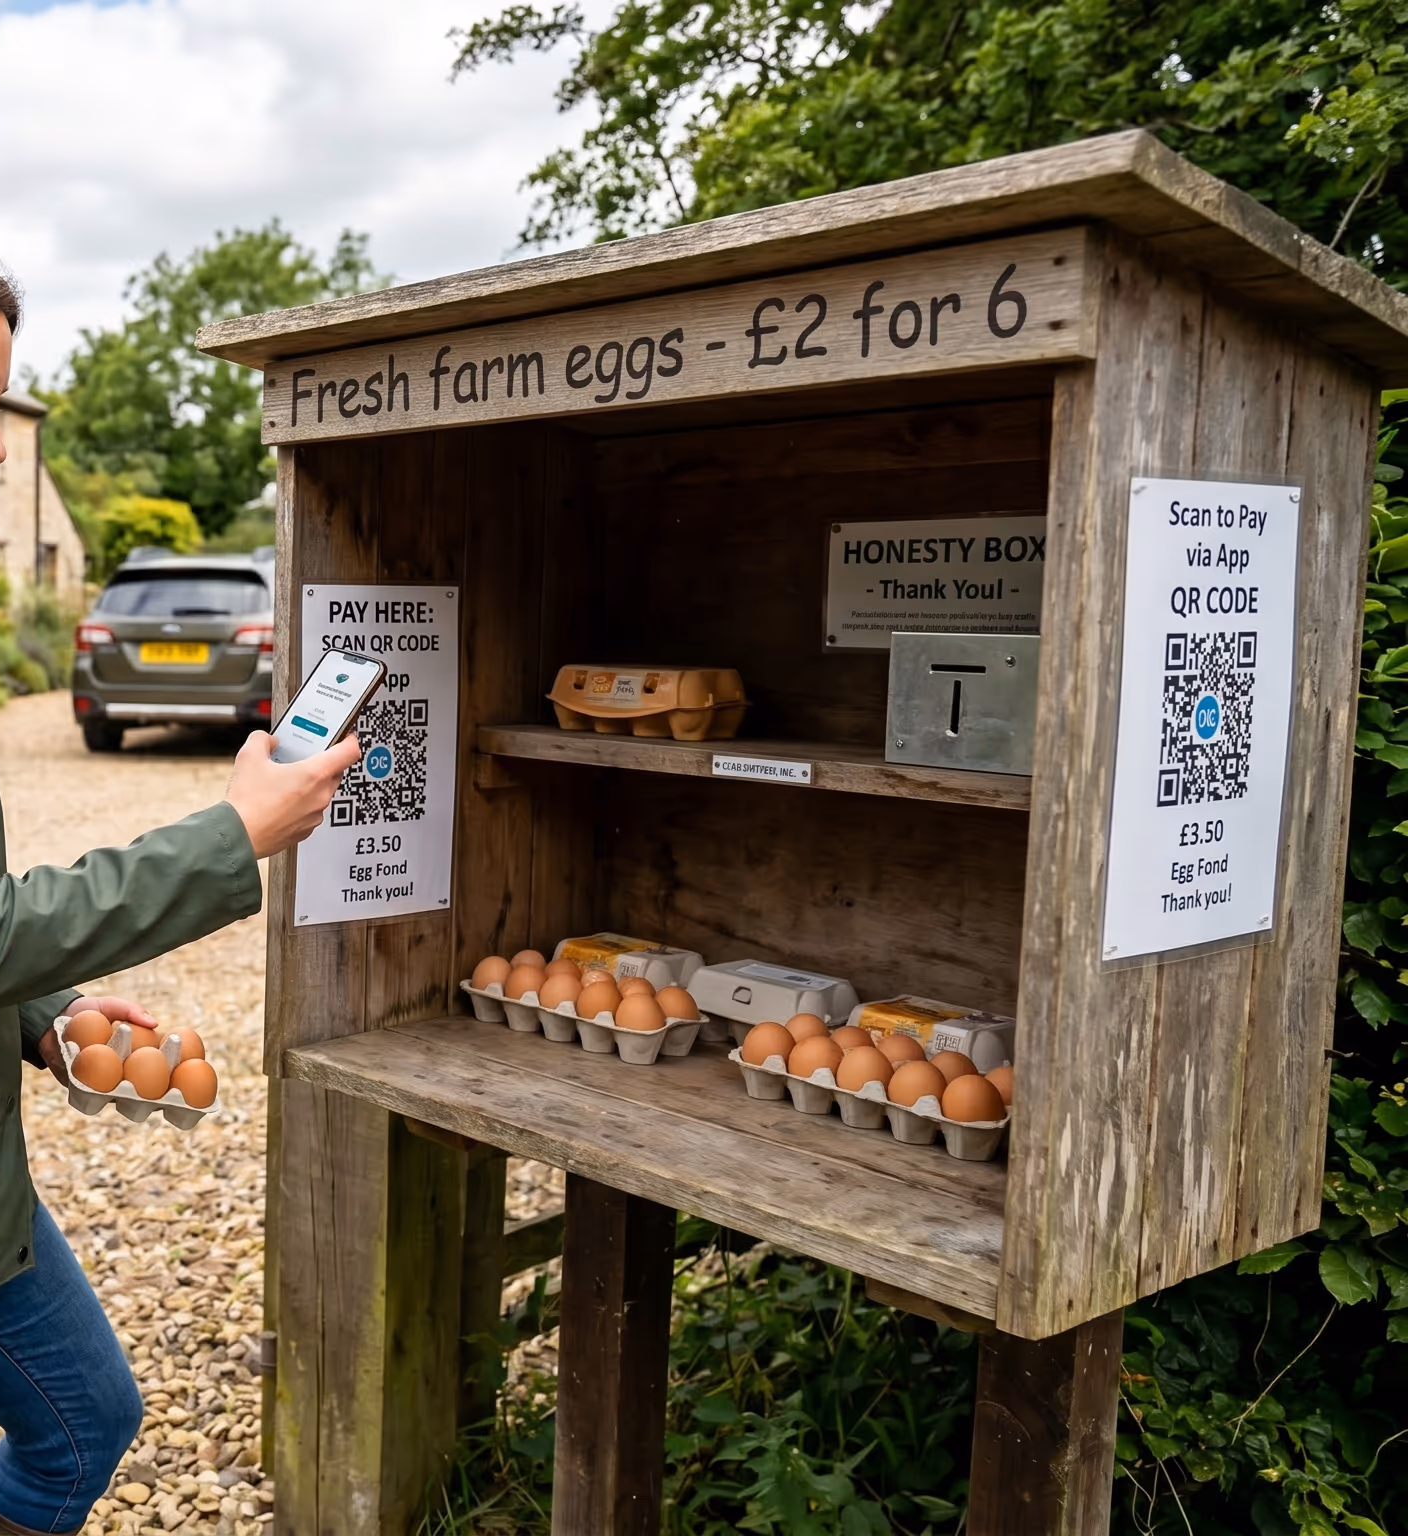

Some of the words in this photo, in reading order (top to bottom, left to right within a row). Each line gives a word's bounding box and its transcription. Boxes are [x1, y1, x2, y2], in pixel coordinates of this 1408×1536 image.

[291, 353, 410, 428] Fresh
[429, 345, 545, 411] farm
[565, 327, 684, 403] eggs
[705, 340, 727, 351] -
[744, 293, 829, 369] £2
[852, 280, 961, 358] for
[987, 263, 1028, 339] 6
[1169, 500, 1212, 527] Scan
[1216, 504, 1235, 528] to
[1239, 504, 1268, 537] Pay
[843, 537, 976, 565] HONESTY
[983, 535, 1047, 563] BOX
[1186, 541, 1212, 567] via
[1216, 542, 1250, 574] App
[879, 578, 947, 600] Thank
[1170, 586, 1201, 618] QR
[1206, 586, 1259, 614] CODE
[329, 600, 369, 624] PAY
[375, 600, 434, 624] HERE:
[321, 634, 366, 652] SCAN
[370, 634, 394, 655] QR
[397, 634, 440, 652] CODE
[355, 834, 402, 855] £3.50
[1178, 819, 1224, 847] £3.50
[349, 865, 373, 882] Egg
[376, 859, 408, 877] Fond
[1170, 861, 1194, 884] Egg
[1197, 852, 1229, 877] Fond
[341, 885, 383, 902] Thank
[385, 881, 414, 902] you!
[1161, 889, 1202, 913] Thank
[1204, 882, 1232, 911] you!
